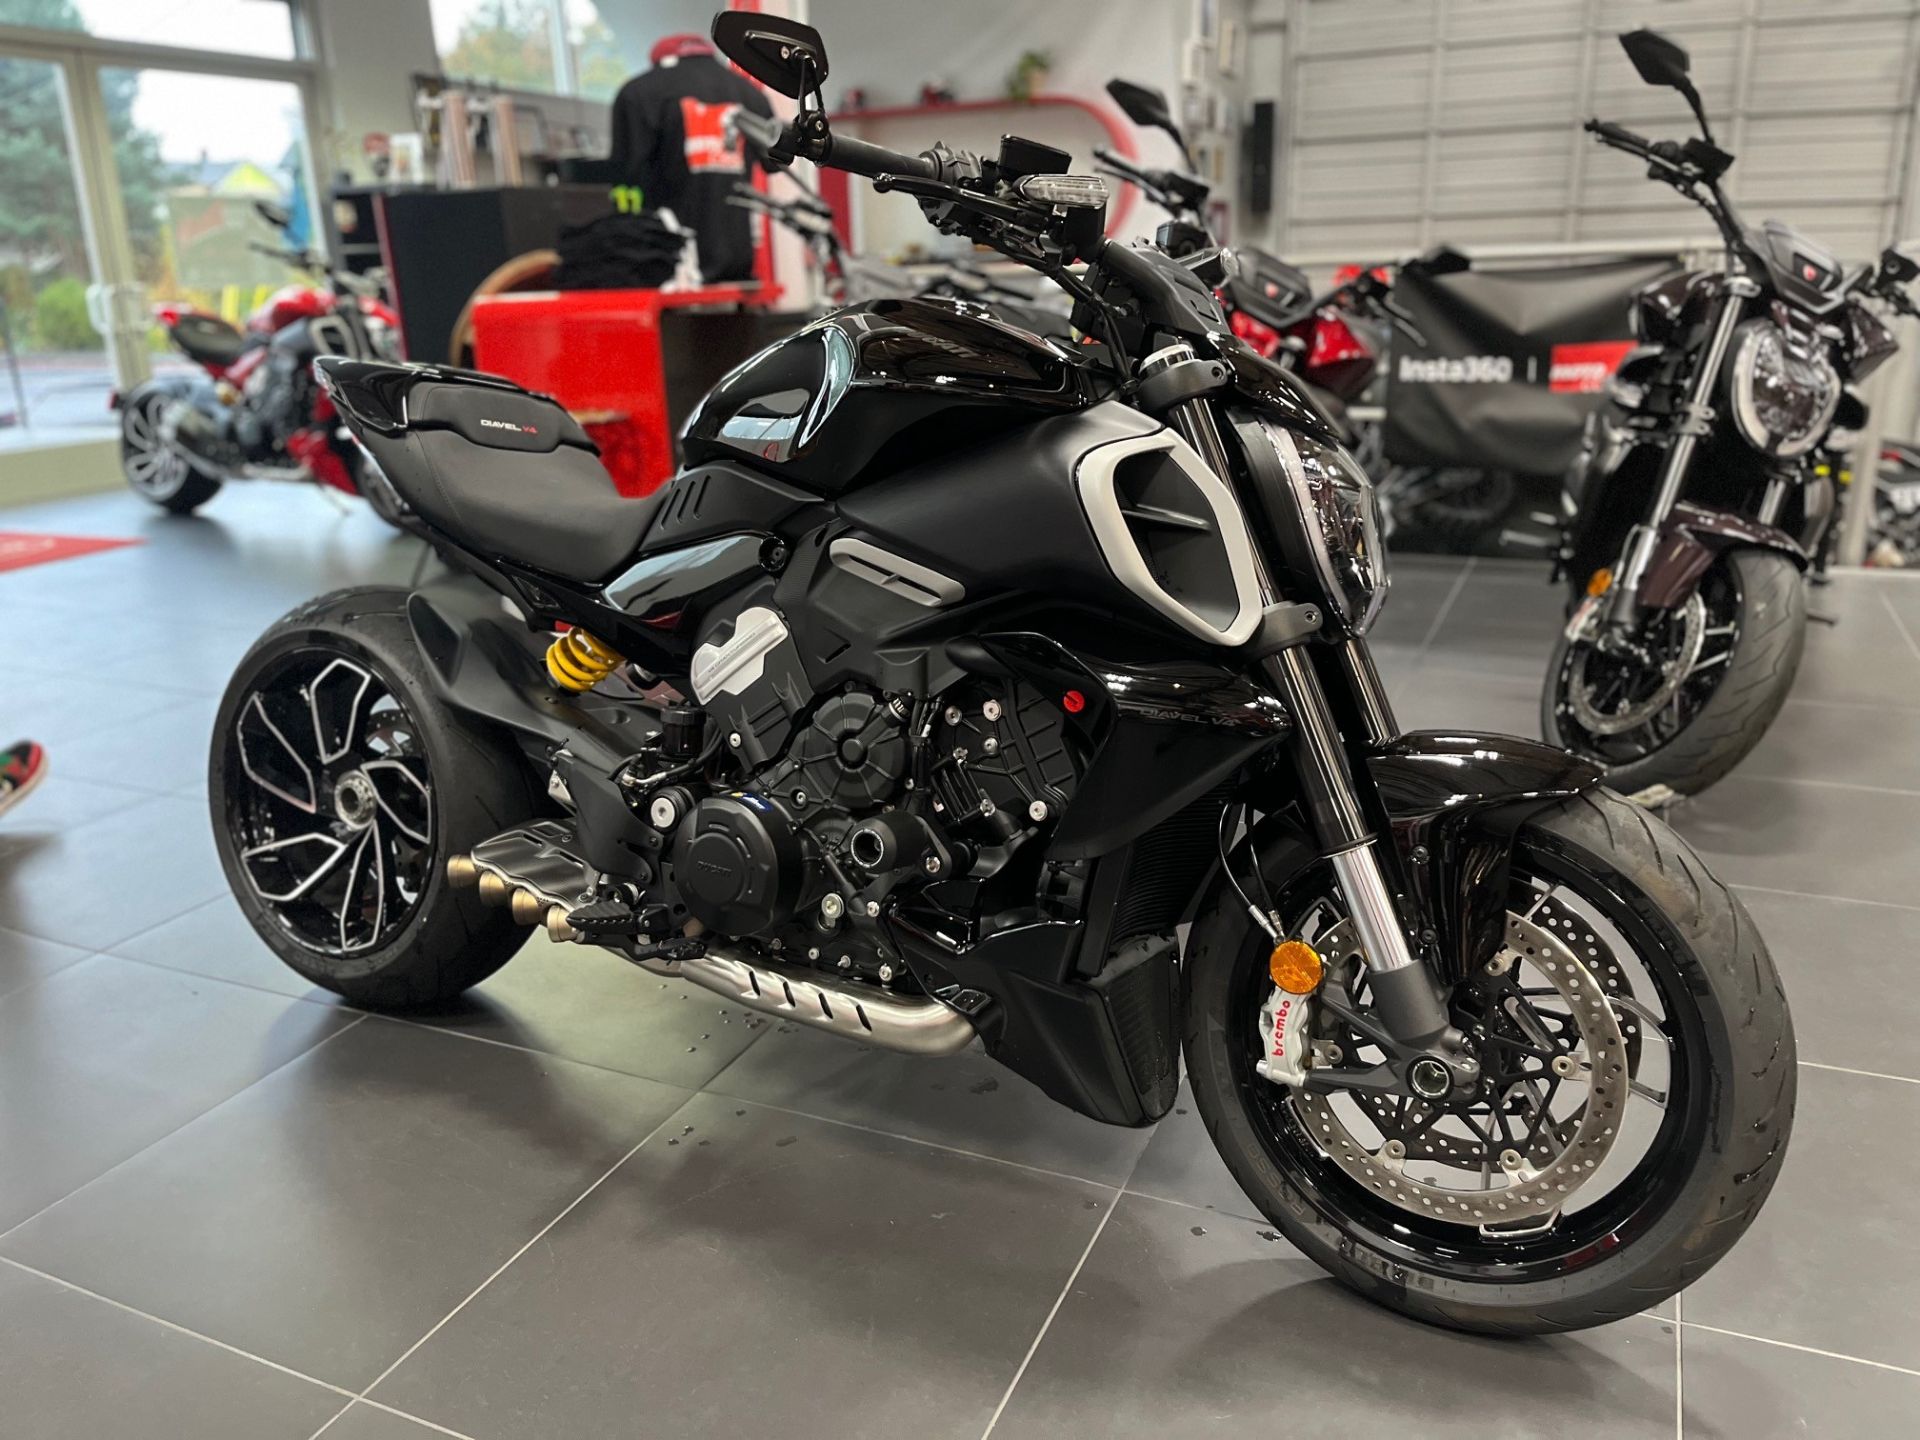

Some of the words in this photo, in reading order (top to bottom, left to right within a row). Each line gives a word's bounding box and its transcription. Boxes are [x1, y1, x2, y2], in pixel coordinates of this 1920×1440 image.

[1398, 354, 1514, 383] Insta360
[480, 419, 522, 432] DIAVEL
[1139, 708, 1208, 724] DIAVEL
[1211, 716, 1242, 727] V4
[1272, 1000, 1291, 1057] brembo
